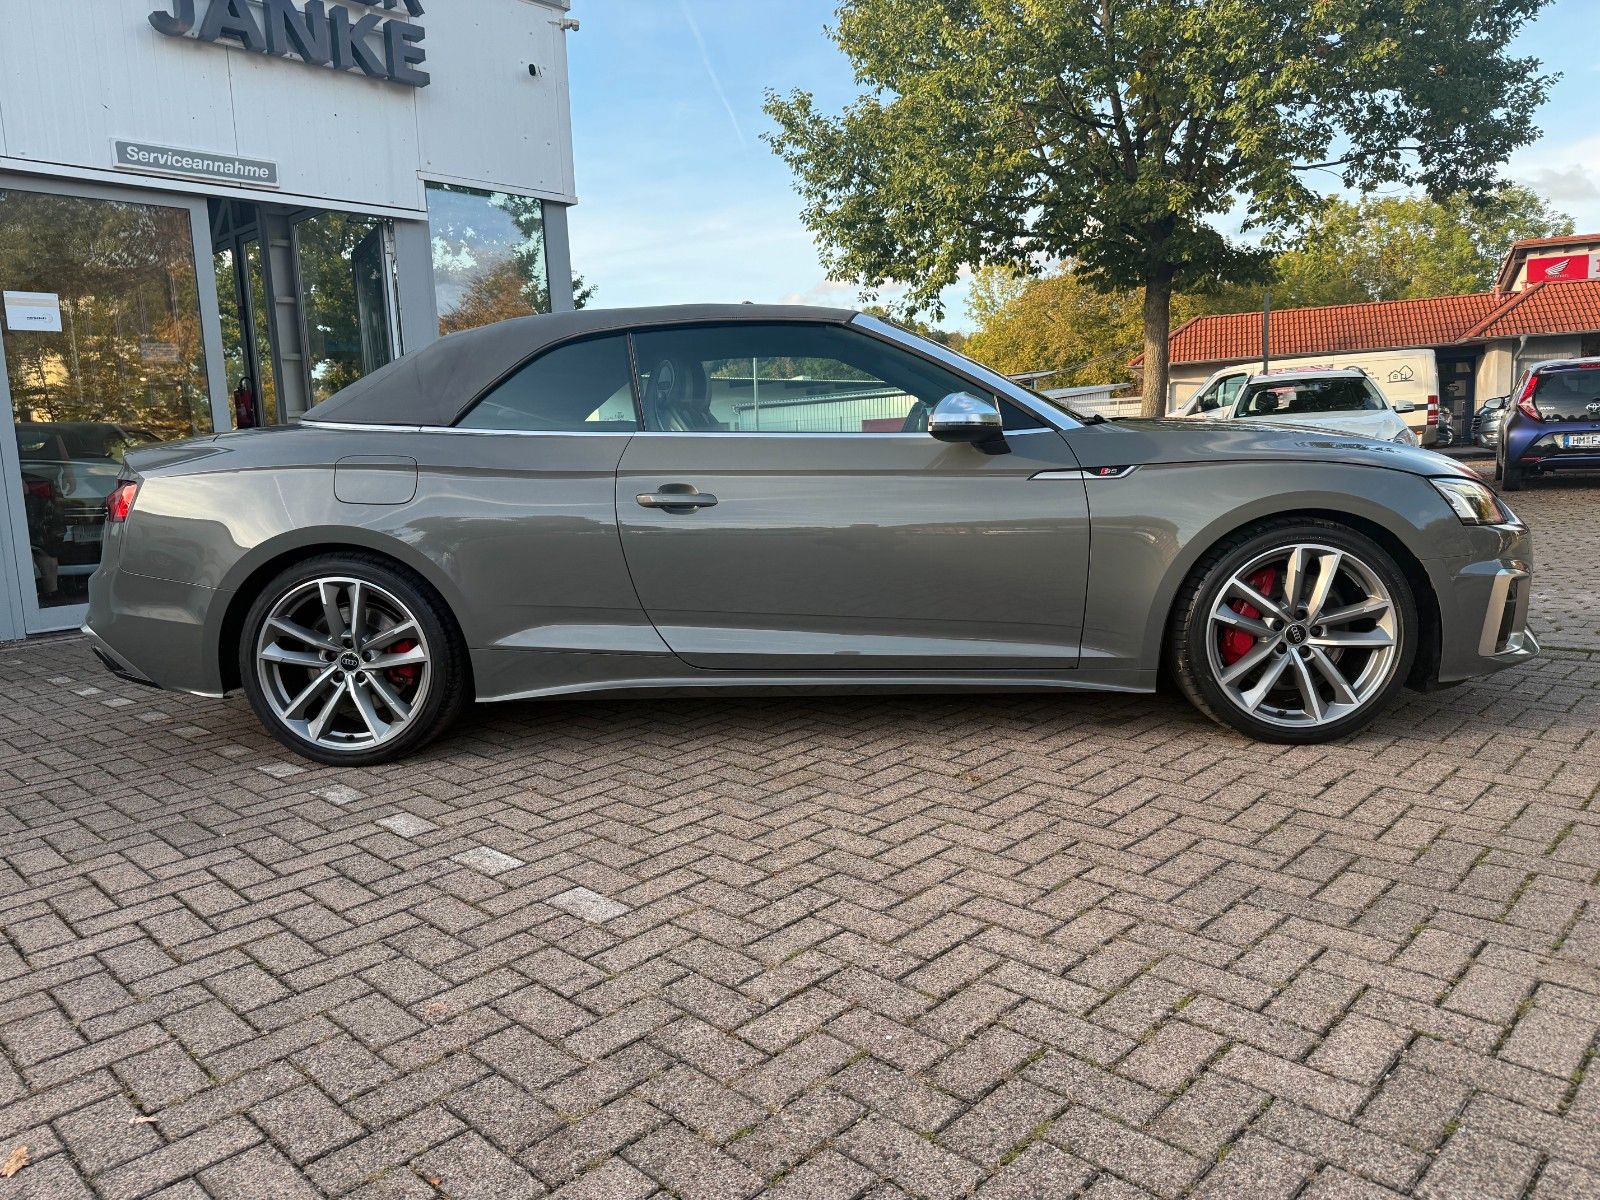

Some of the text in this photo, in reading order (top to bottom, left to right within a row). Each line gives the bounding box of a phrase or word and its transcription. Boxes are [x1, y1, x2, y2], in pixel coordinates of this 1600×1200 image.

[148, 0, 430, 88] JANKE
[126, 145, 269, 179] Serviceannahme
[1572, 436, 1600, 445] HM F
